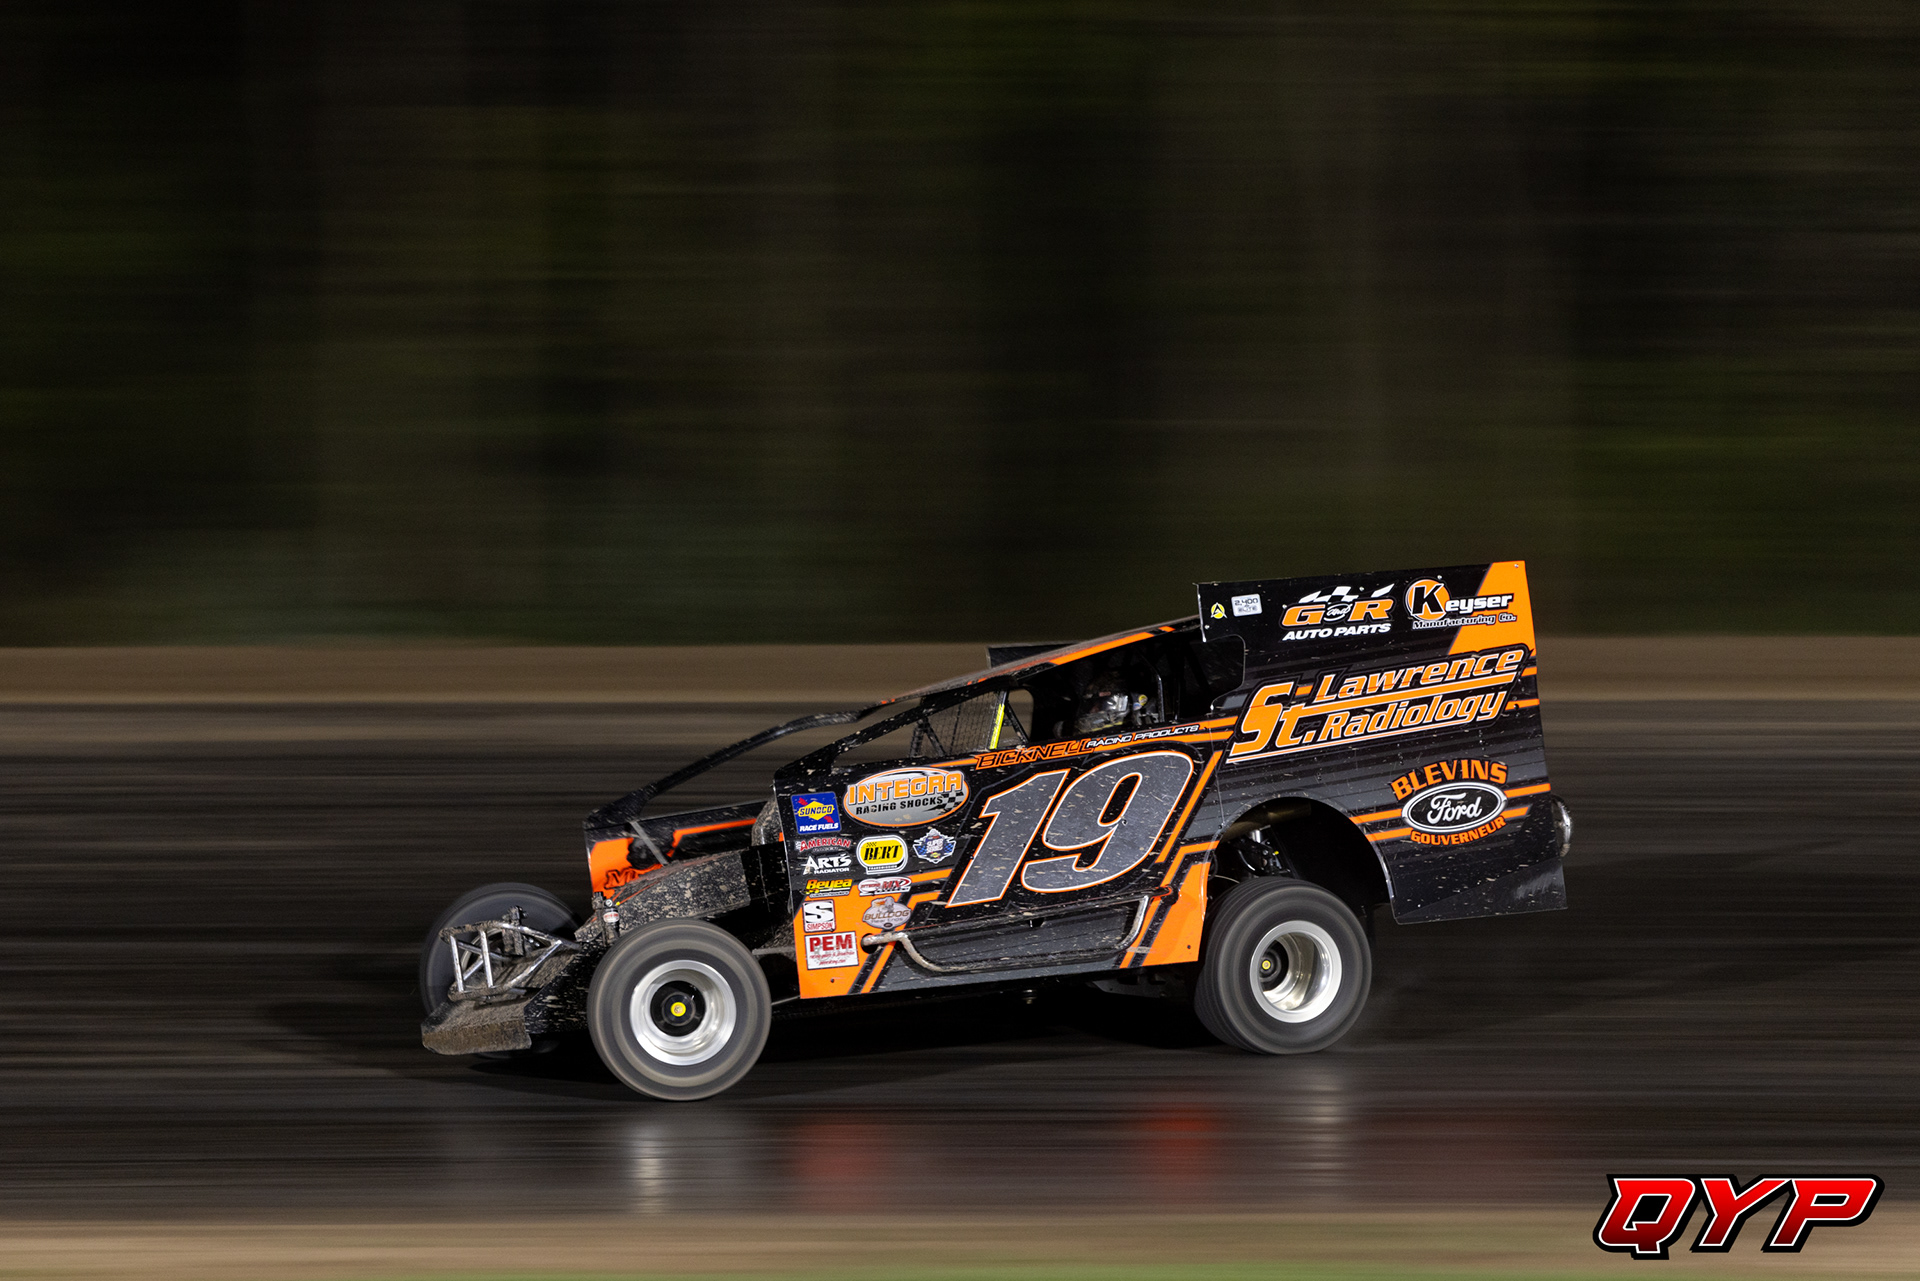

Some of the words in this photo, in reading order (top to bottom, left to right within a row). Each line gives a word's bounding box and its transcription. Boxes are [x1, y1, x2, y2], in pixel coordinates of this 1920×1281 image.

[1410, 583, 1513, 616] Keyser
[1282, 604, 1326, 627] G
[1347, 599, 1394, 622] R
[1412, 615, 1496, 630] Manufacturing
[1498, 612, 1517, 624] Co.
[1282, 628, 1333, 641] AUTO
[1334, 623, 1392, 637] PARTS
[1229, 681, 1318, 757] St.
[1312, 648, 1525, 703] Lawrence
[1316, 690, 1507, 742] Radiology
[975, 737, 1093, 770] BICKNELL
[1086, 734, 1133, 748] RACING
[1134, 724, 1200, 741] PRODUCTS
[848, 771, 965, 805] INTEGRA
[1391, 759, 1508, 801] BLEVINS
[799, 805, 833, 816] SUNOCO
[855, 803, 897, 815] RACING
[899, 796, 943, 809] SHOCKS
[1427, 792, 1483, 825] Ford
[799, 824, 817, 832] RACE
[818, 822, 839, 830] FUELS
[945, 750, 1194, 909] 19
[1410, 815, 1507, 846] GOUVERNEUR
[800, 837, 851, 852] AMERICAN
[863, 844, 902, 861] BERT
[806, 878, 853, 890] Beyea
[864, 909, 910, 921] BULLDOG
[806, 922, 834, 931] SIMPSON
[809, 933, 853, 953] PEM
